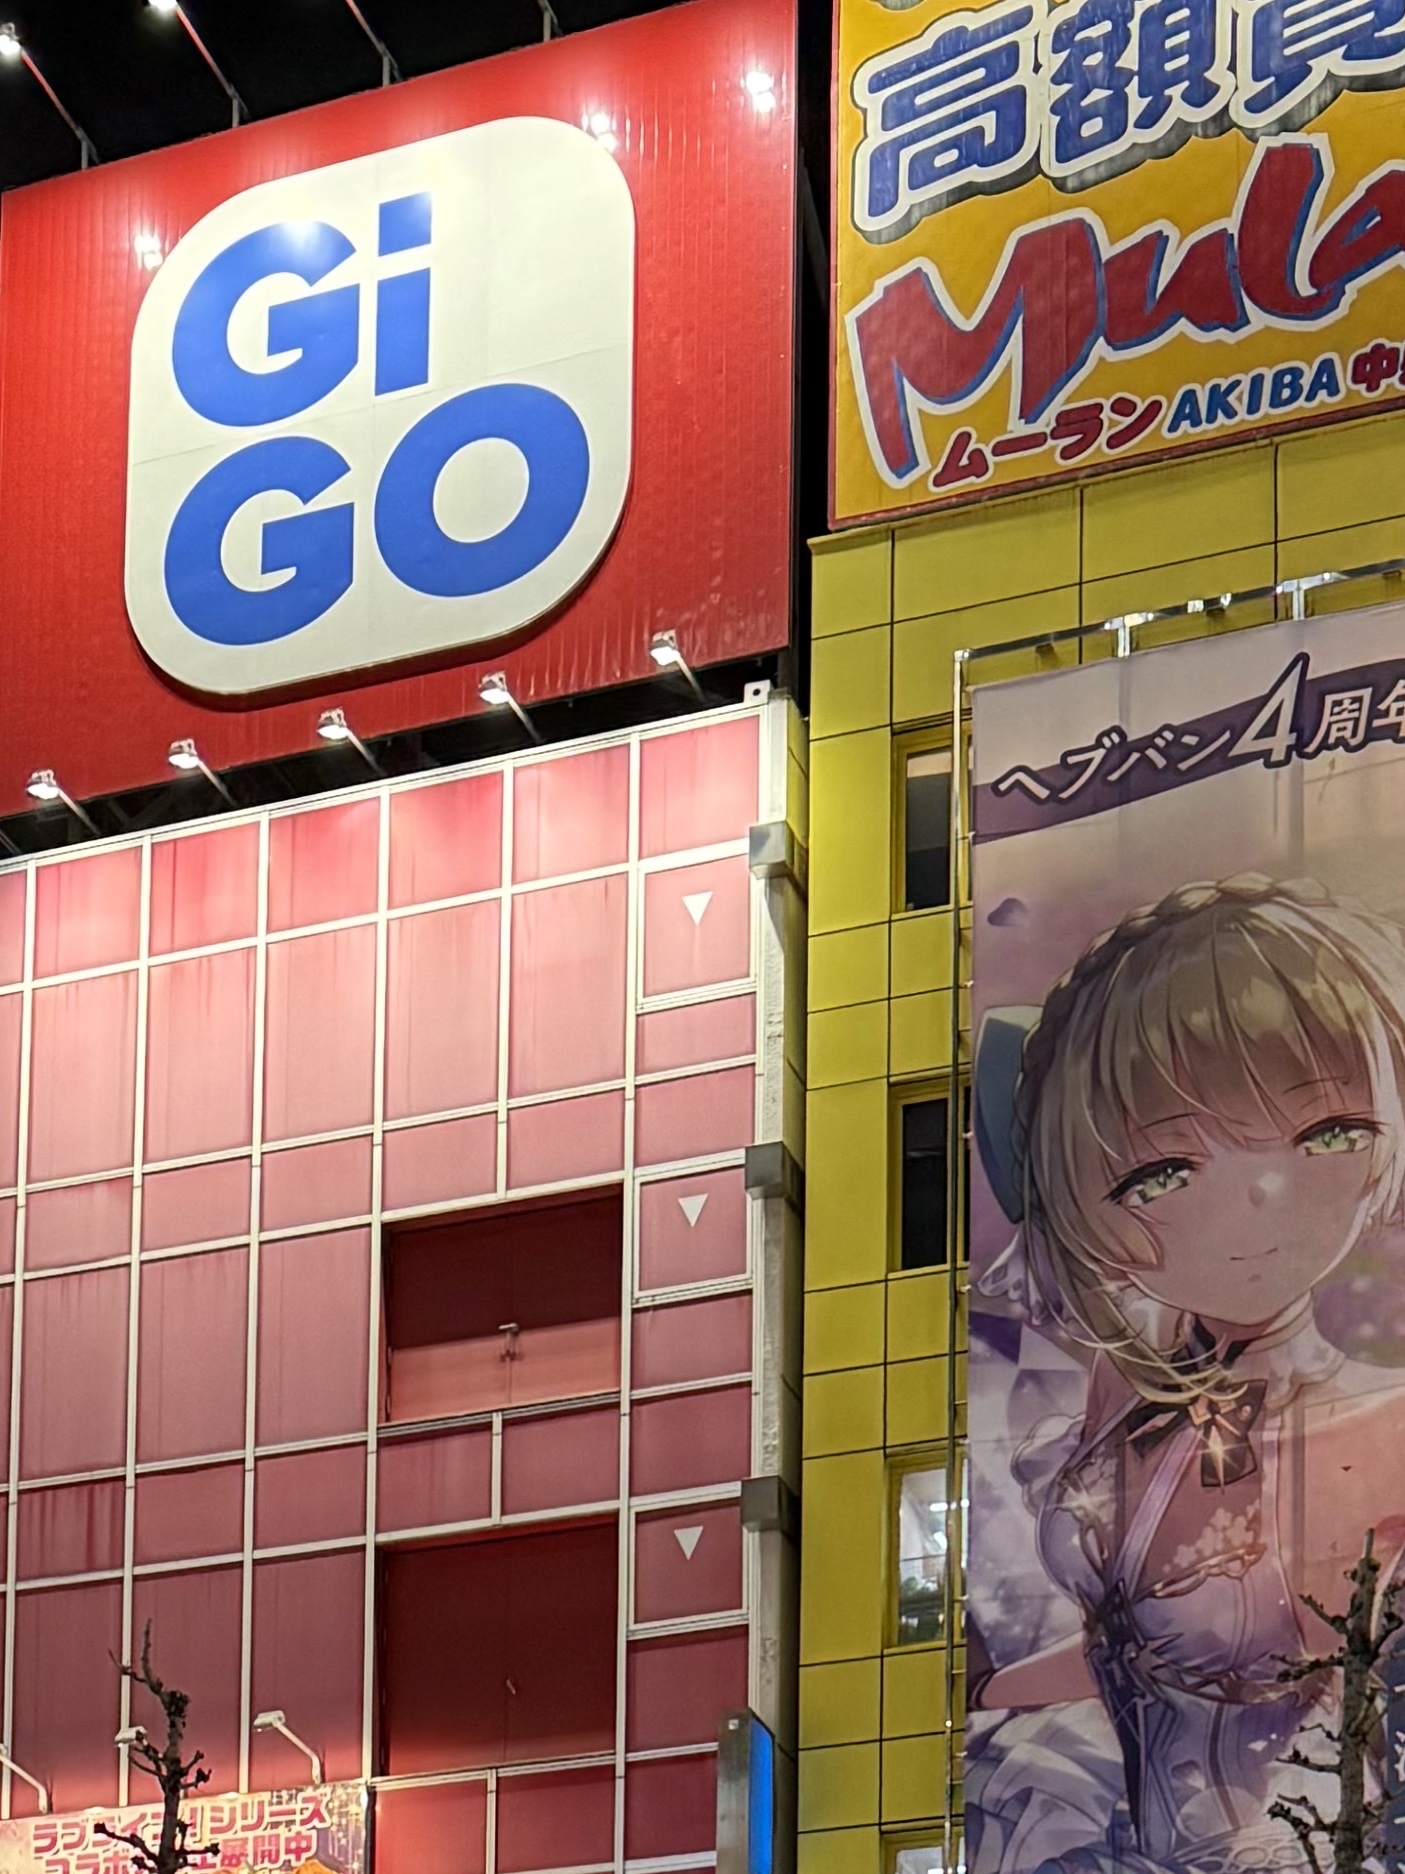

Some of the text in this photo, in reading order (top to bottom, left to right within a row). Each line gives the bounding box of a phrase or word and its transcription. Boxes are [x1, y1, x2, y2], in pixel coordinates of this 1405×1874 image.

[930, 396, 1162, 489] ムーラン
[1166, 356, 1340, 435] AKIBA
